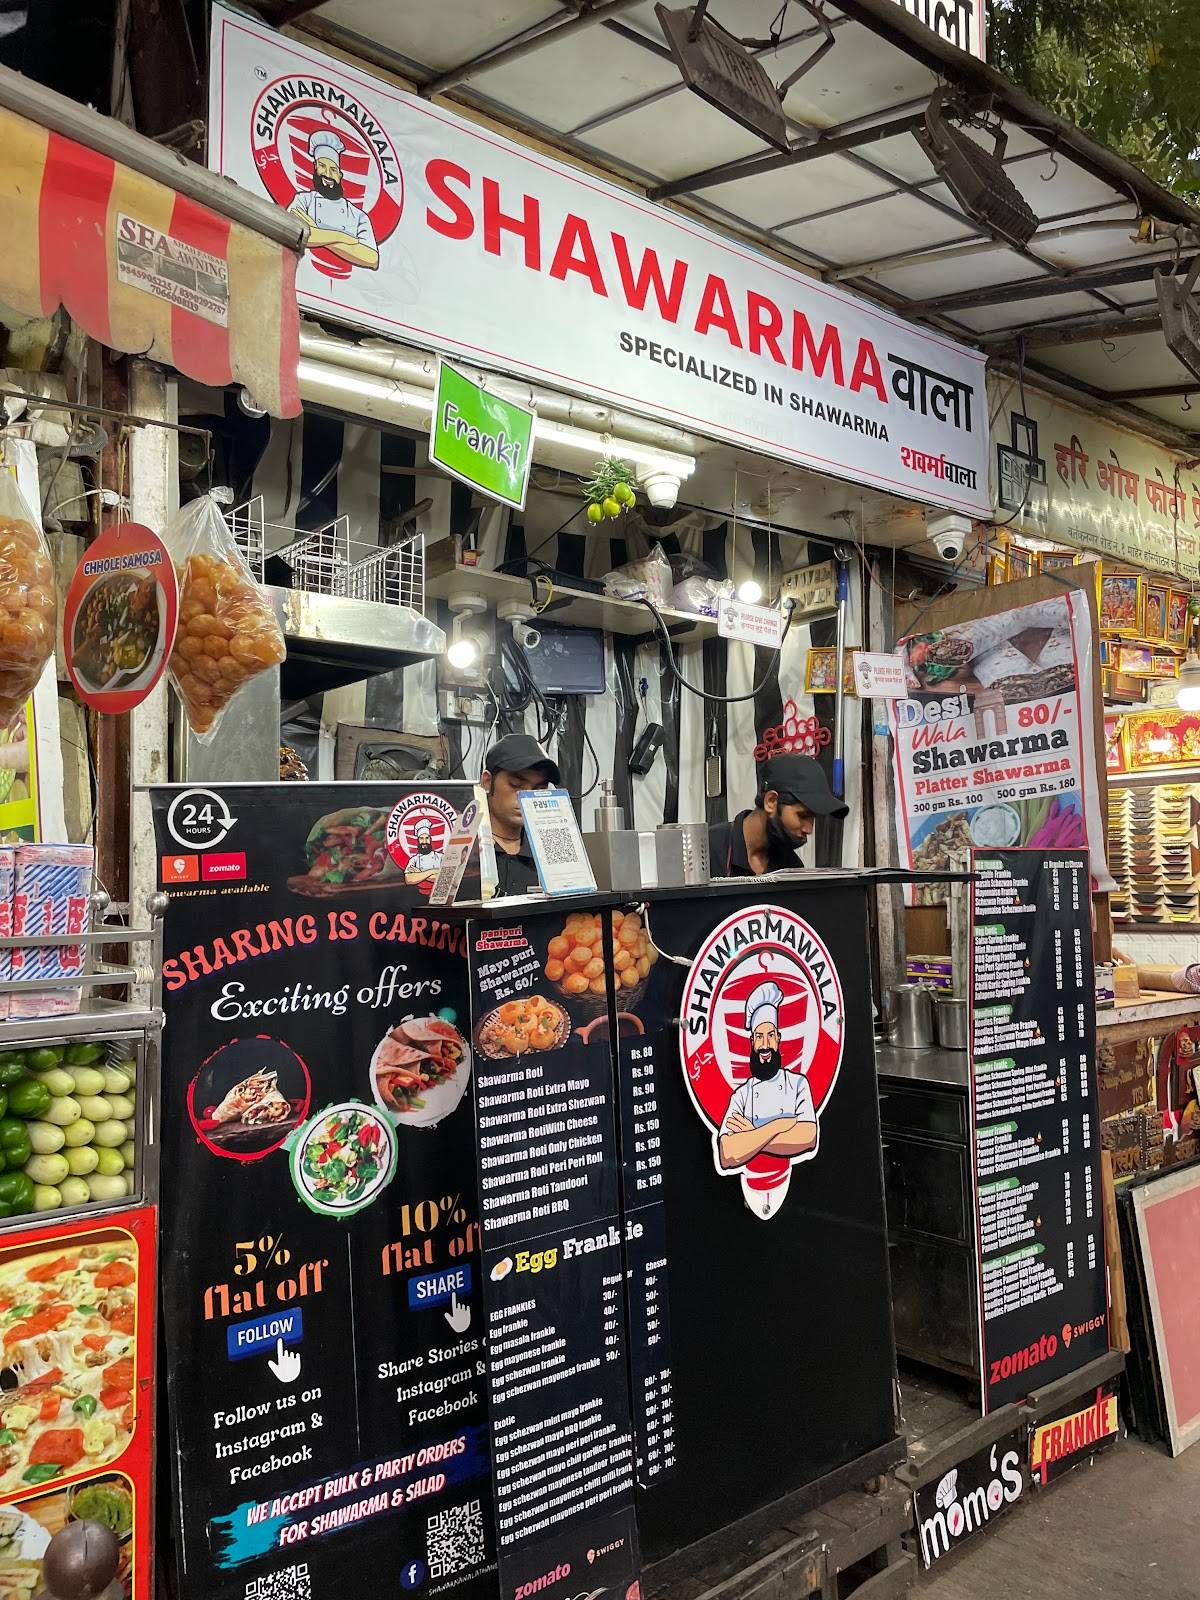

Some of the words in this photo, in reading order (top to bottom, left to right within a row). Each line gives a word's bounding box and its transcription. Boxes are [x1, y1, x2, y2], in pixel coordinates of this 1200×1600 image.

[256, 80, 398, 185] SHAWARMAWALA
[120, 217, 174, 259] SFA
[177, 251, 226, 280] AWNING
[424, 157, 889, 404] SHAWARMA
[619, 331, 757, 397] SPECIALIZED
[764, 382, 784, 407] IN
[789, 392, 890, 443] SHAWARMA
[887, 352, 974, 434] वाला
[443, 400, 520, 470] Franki
[900, 445, 977, 490] शवर्मावाला
[1054, 434, 1090, 489] हरि
[1096, 448, 1140, 507] ओम
[84, 556, 120, 577] CHHOLE
[121, 549, 164, 570] SAMOSA
[897, 685, 972, 729] Desi
[1018, 698, 1073, 728] 80/-
[911, 720, 966, 750] Wala
[912, 728, 1069, 775] Shawarma
[915, 775, 968, 796] Platter
[972, 757, 1070, 786] Shawarma
[914, 801, 930, 812] 300
[932, 802, 947, 813] gm
[948, 797, 964, 808] Rs.
[965, 793, 983, 805] 100
[997, 788, 1017, 799] 500
[1019, 786, 1038, 798] gm
[1040, 781, 1057, 793] Rs.
[1059, 777, 1076, 790] 180
[181, 803, 214, 825] 24
[186, 826, 212, 835] HOURS
[388, 795, 457, 838] SHAWARMAWAL
[209, 864, 241, 873] zomato
[220, 883, 270, 895] available
[162, 915, 318, 991] SHARING
[328, 911, 358, 941] IS
[476, 938, 528, 951] Shawarma
[482, 926, 522, 940] panipuri
[477, 957, 510, 978] Mayo
[511, 945, 535, 963] puri
[479, 959, 541, 993] Shawarma
[689, 918, 837, 1036] SHAWARMAWALA
[210, 981, 350, 1022] Exciting
[356, 964, 442, 1010] offers
[494, 985, 514, 1000] Rs.
[515, 973, 539, 991] 60/-
[631, 1050, 642, 1059] Rs.
[643, 1046, 653, 1057] 80
[478, 1071, 524, 1088] Shawarma
[526, 1066, 543, 1079] Roti
[632, 1068, 643, 1078] Rs.
[644, 1064, 654, 1075] 90
[479, 1090, 525, 1108] Shawarma
[527, 1085, 544, 1099] Roti
[545, 1083, 566, 1095] Extra
[567, 1078, 589, 1091] Mayo
[479, 1110, 526, 1128] Shawarma
[527, 1105, 545, 1118] Roti
[546, 1102, 567, 1115] Extra
[568, 1095, 605, 1110] Shezwan
[480, 1130, 527, 1149] Shawarma
[567, 1115, 598, 1130] Cheese
[481, 1150, 528, 1169] Shawarma
[529, 1144, 547, 1158] Roti
[548, 1140, 567, 1154] Only
[568, 1134, 602, 1149] Chicken
[482, 1170, 529, 1190] Shawarma
[530, 1163, 548, 1178] Roti
[549, 1159, 567, 1174] Peri
[568, 1155, 585, 1169] Peri
[586, 1151, 603, 1165] Roll
[483, 1190, 530, 1210] Shawarma
[531, 1183, 549, 1198] Roti
[550, 1174, 588, 1193] Tandoori
[400, 1192, 467, 1236] 10%
[484, 1210, 531, 1231] Shawarma
[532, 1203, 550, 1218] Roti
[551, 1198, 569, 1213] BBQ
[233, 1232, 291, 1276] 5%
[381, 1239, 433, 1276] flat
[515, 1247, 558, 1274] Egg
[204, 1279, 267, 1320] flat
[277, 1258, 329, 1302] off
[416, 1271, 465, 1299] SHARE
[237, 1316, 294, 1346] FOLLOW
[1073, 1315, 1105, 1338] SWIGGY
[377, 1355, 424, 1380] Share
[428, 1339, 479, 1366] Stories
[990, 1333, 1058, 1385] zomato
[396, 1368, 473, 1403] Instagram
[213, 1401, 271, 1429] Follow
[277, 1394, 297, 1410] us
[301, 1386, 323, 1404] on
[408, 1392, 479, 1427] Facebook
[215, 1421, 306, 1459] Instagram
[310, 1412, 324, 1428] &
[1039, 1387, 1112, 1485] FRANKIE
[229, 1445, 313, 1485] Facebook
[247, 1504, 269, 1527] WE
[271, 1484, 322, 1520] ACCEPT
[324, 1471, 359, 1501] BULK
[360, 1467, 373, 1486] &
[375, 1453, 414, 1483] PARTY
[416, 1436, 466, 1467] ORDERS
[279, 1522, 308, 1548] FOR
[310, 1497, 388, 1541] SHAWARMA
[391, 1491, 404, 1510] &
[406, 1473, 447, 1504] SALAD
[596, 1538, 625, 1557] SWIGGY
[514, 1563, 571, 1600] zomato
